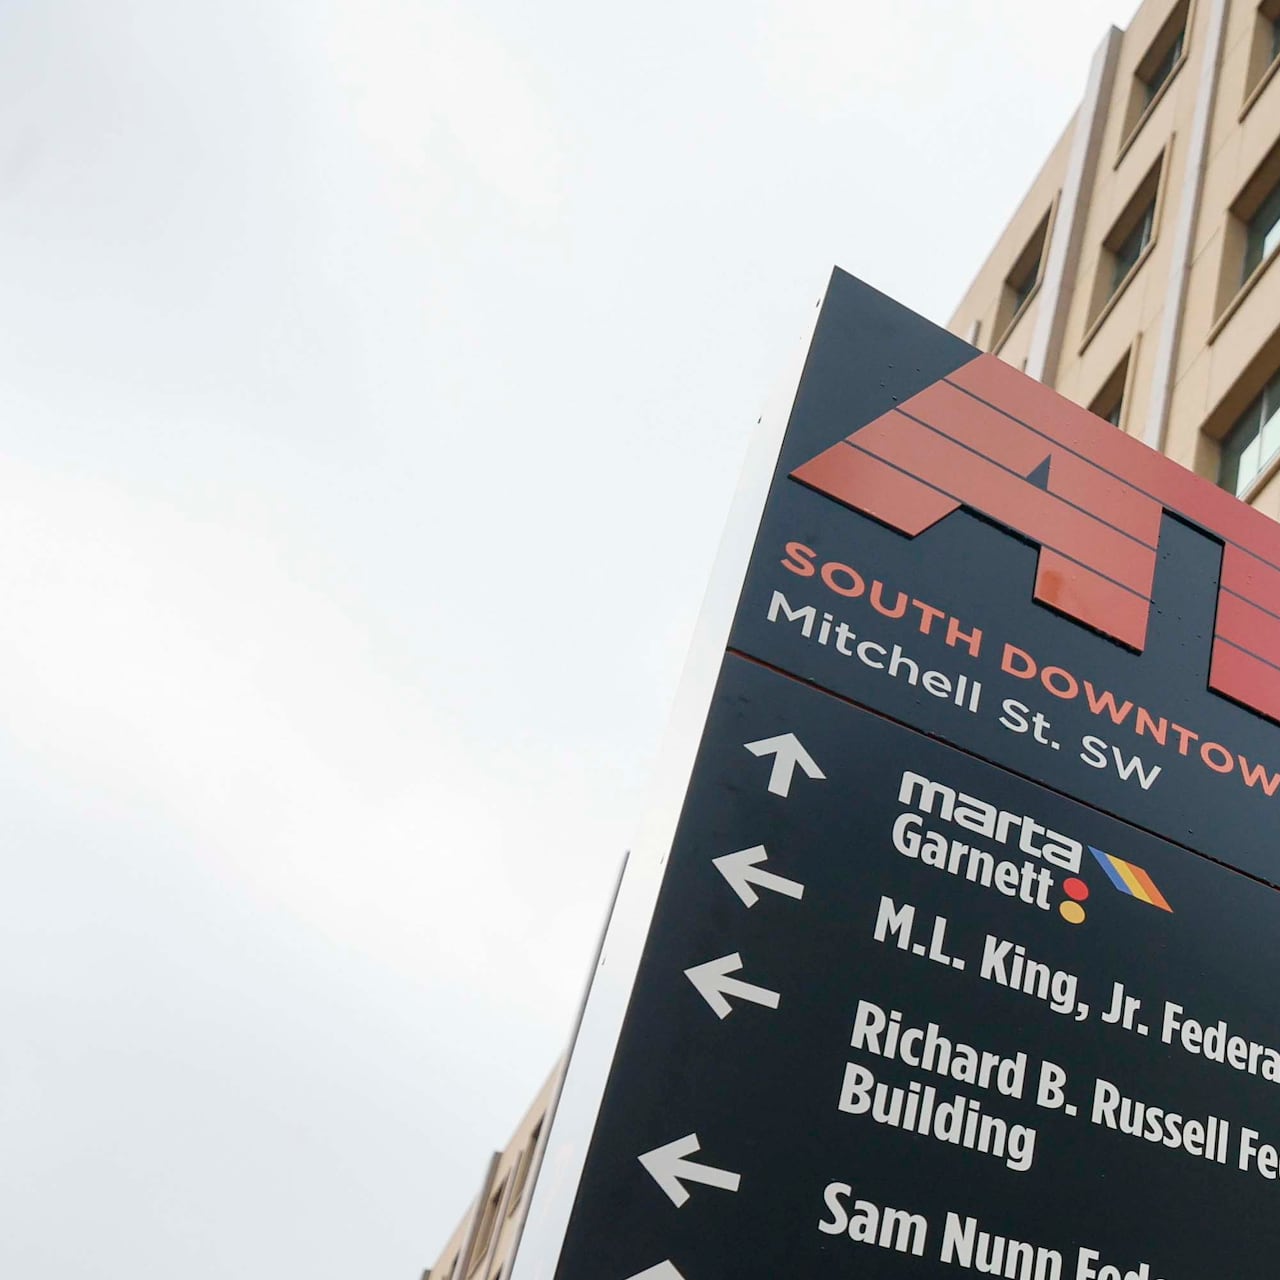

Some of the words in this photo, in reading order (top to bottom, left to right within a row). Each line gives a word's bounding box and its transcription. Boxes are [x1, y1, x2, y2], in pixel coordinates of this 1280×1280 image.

[780, 540, 983, 658] SOUTH
[766, 589, 981, 714] Mitchell
[998, 696, 1062, 751] St.
[1081, 733, 1163, 791] SW
[891, 812, 1054, 913] Garnett
[899, 771, 1083, 874] marta
[873, 895, 966, 970] M.L.
[979, 933, 1090, 1021] King,
[1100, 981, 1150, 1036] Jr.
[837, 1062, 1037, 1173] Building
[850, 999, 1027, 1099] Richard
[1036, 1061, 1078, 1116] B.
[1091, 1078, 1228, 1165] Russell
[817, 1182, 928, 1258] Sam
